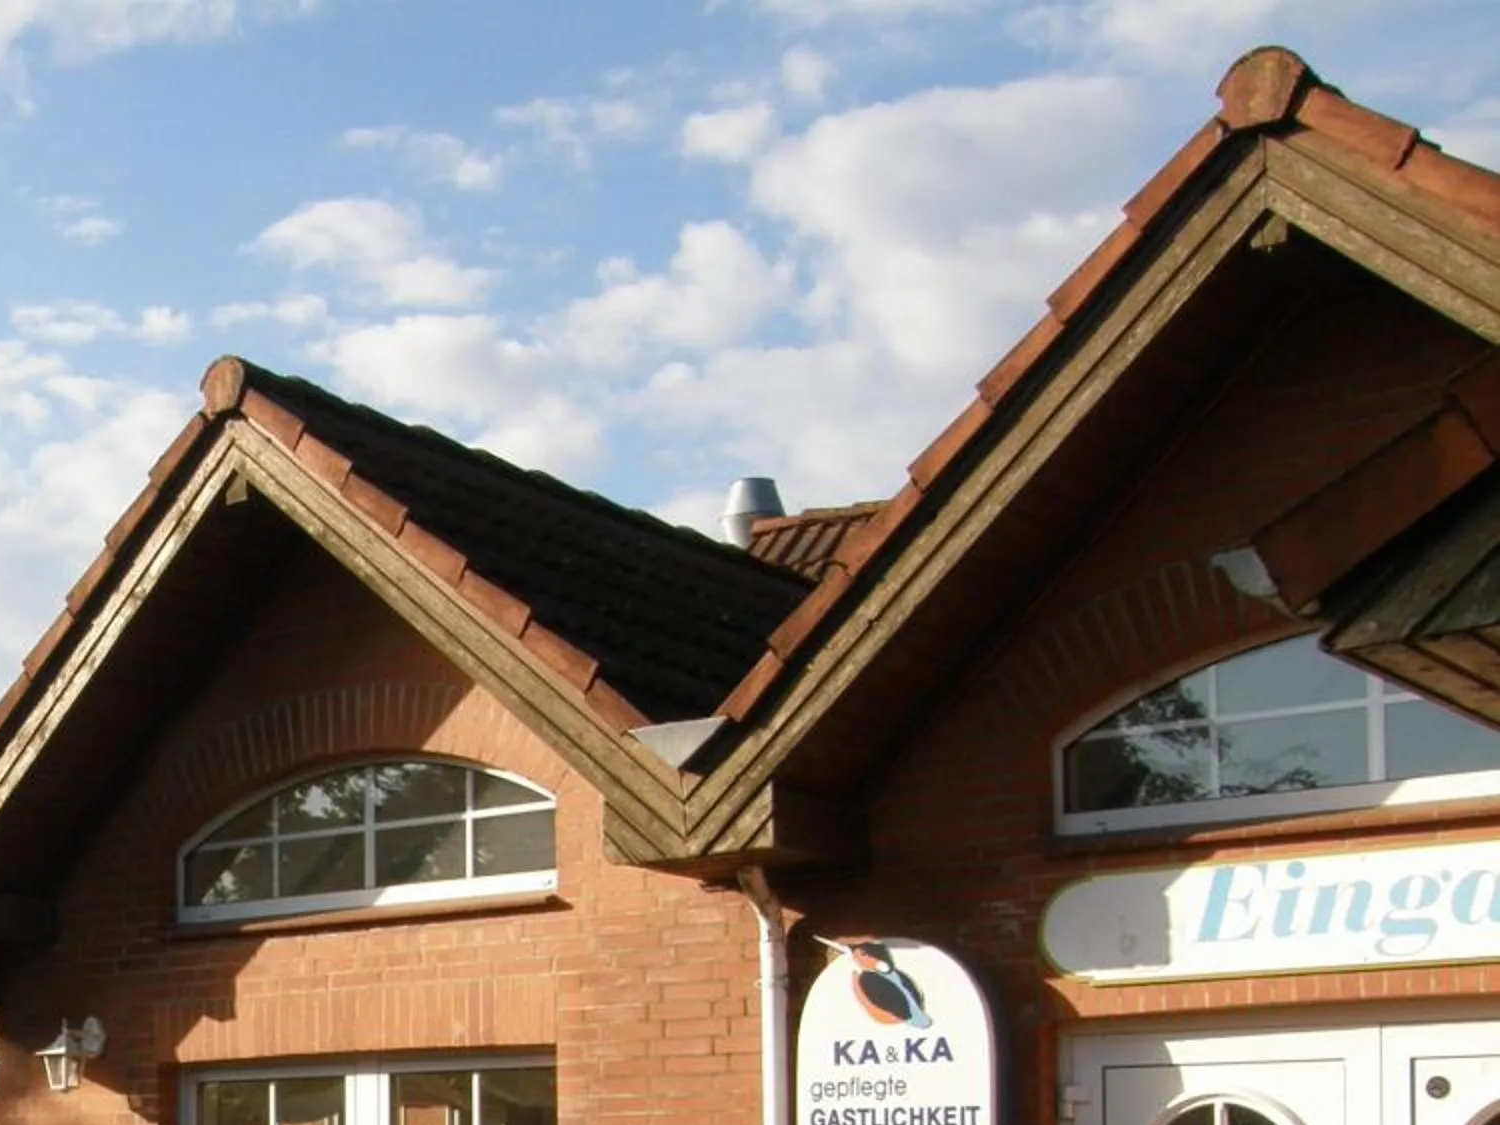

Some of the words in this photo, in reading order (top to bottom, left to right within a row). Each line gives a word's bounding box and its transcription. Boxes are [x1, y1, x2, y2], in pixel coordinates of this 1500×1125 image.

[833, 1040, 880, 1066] KA
[885, 1045, 899, 1063] &
[904, 1037, 953, 1063] KA
[810, 1076, 907, 1102] gepflegte
